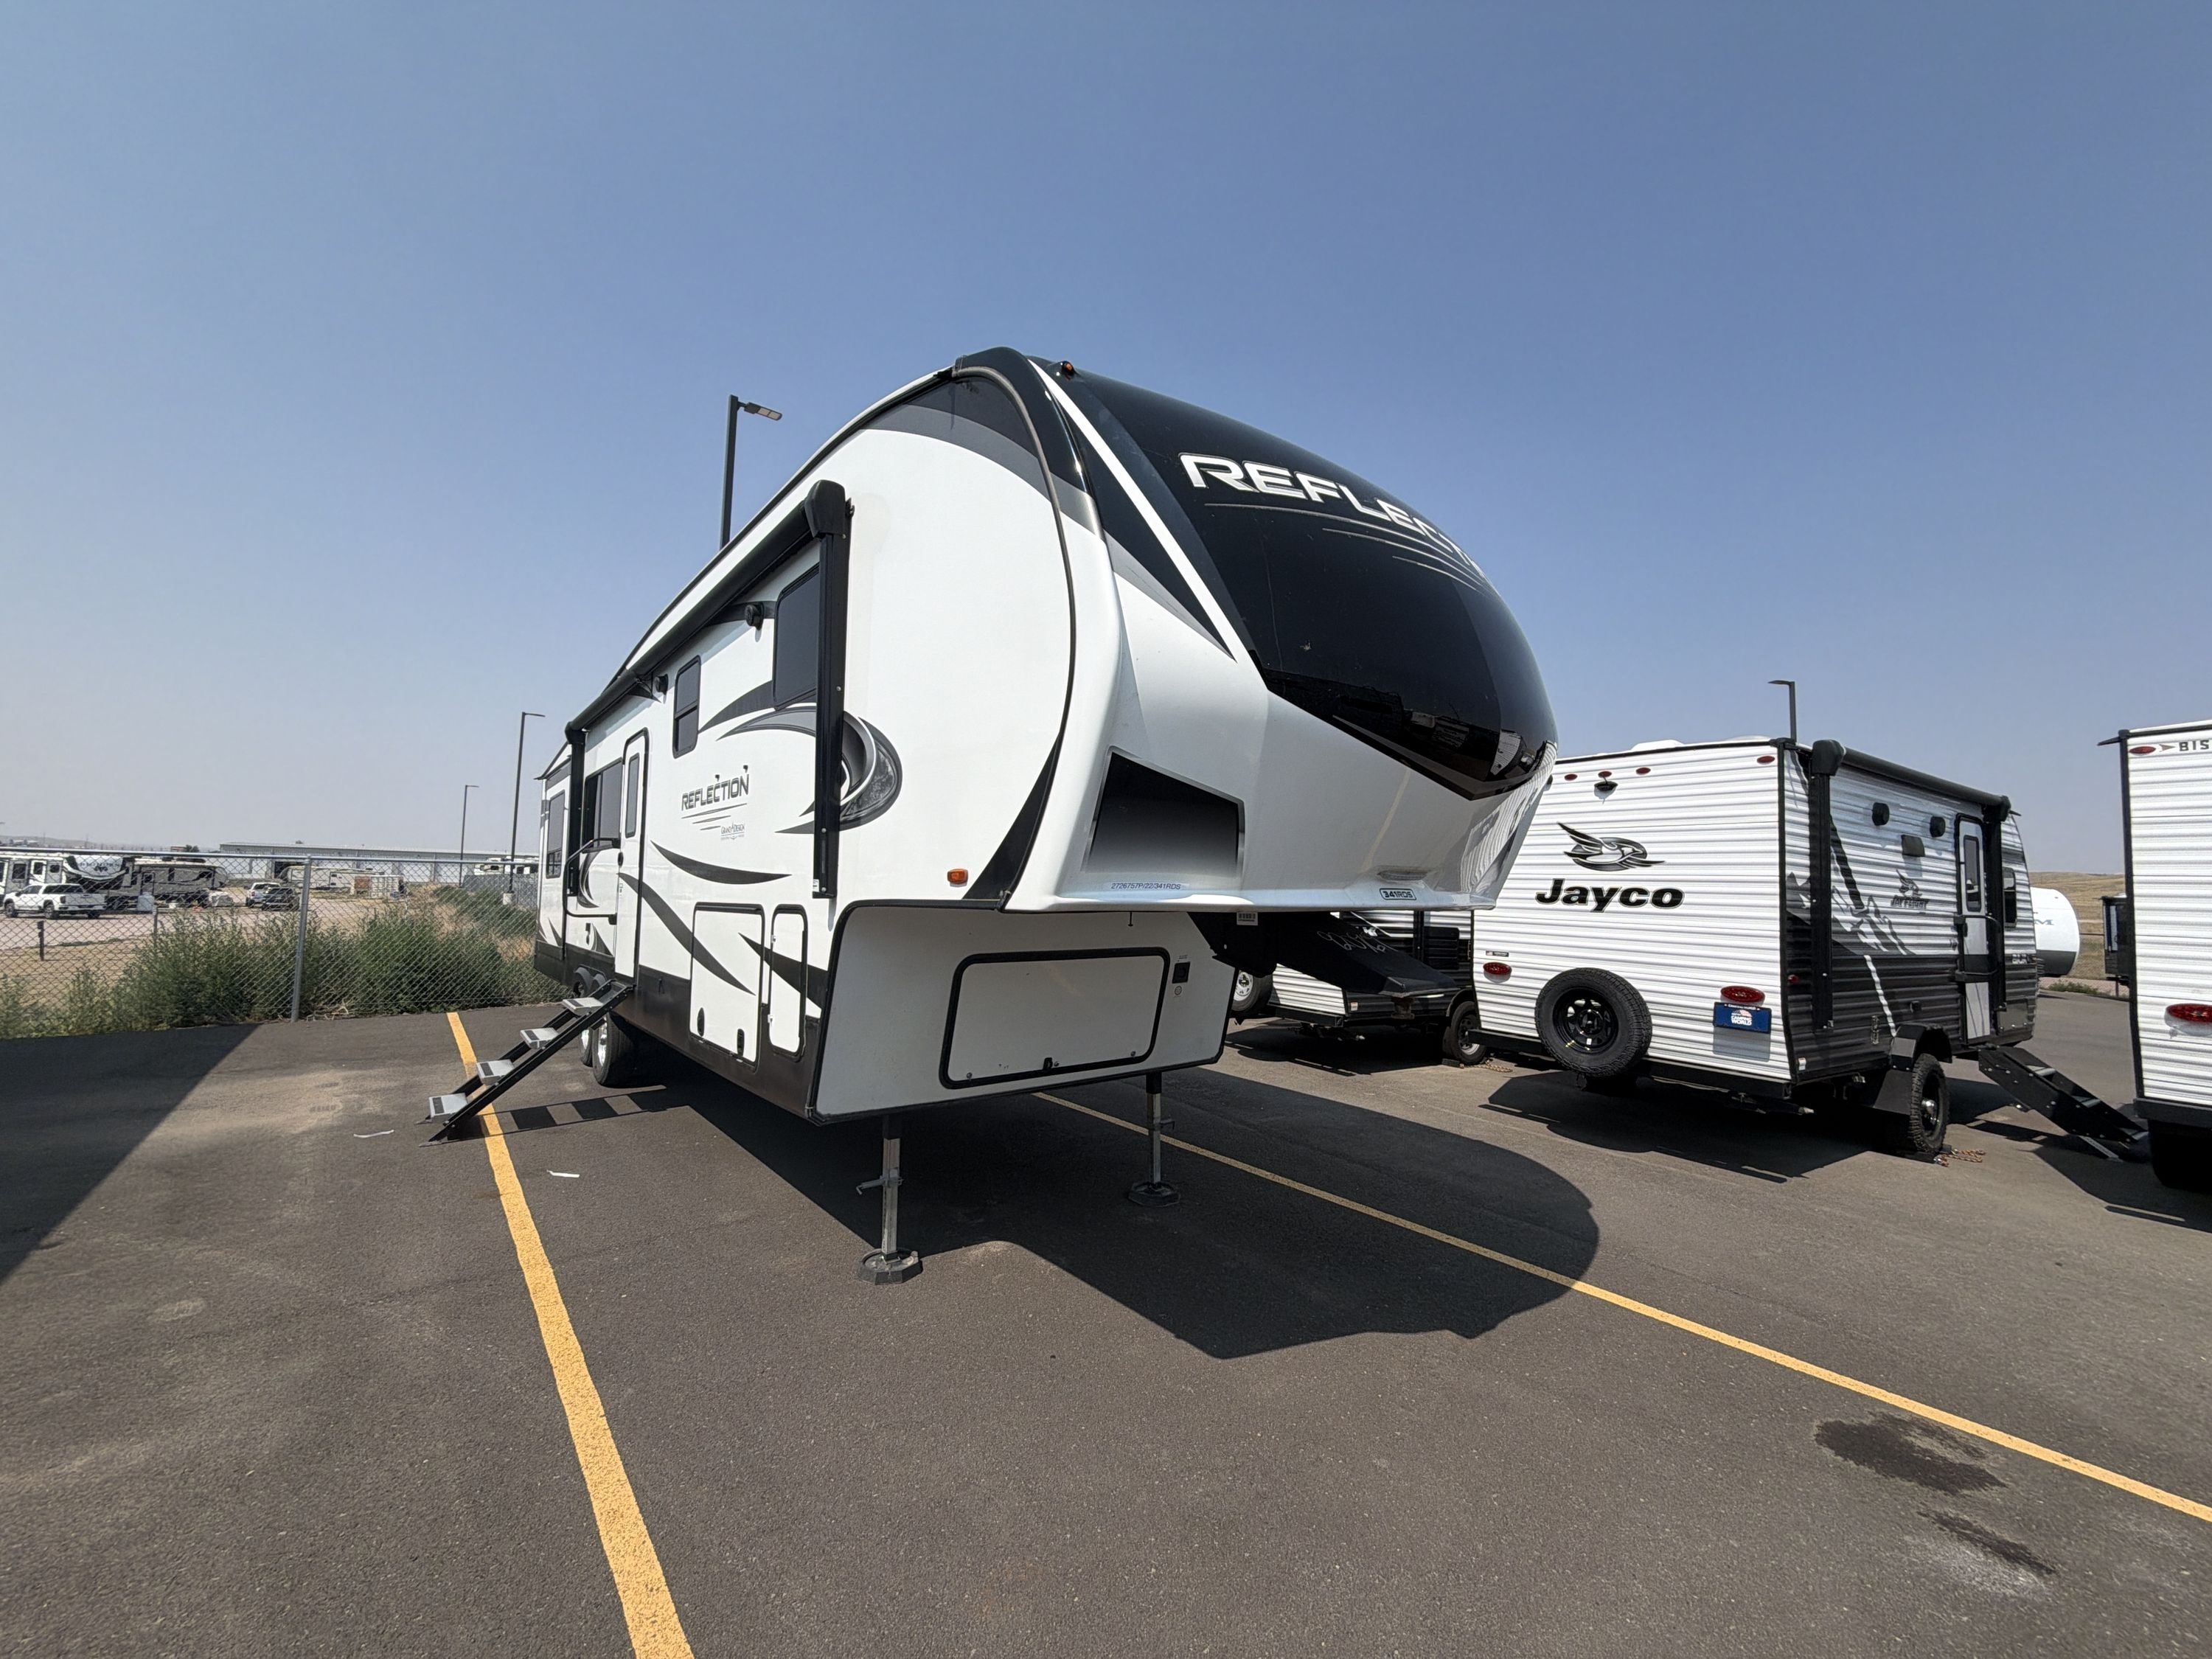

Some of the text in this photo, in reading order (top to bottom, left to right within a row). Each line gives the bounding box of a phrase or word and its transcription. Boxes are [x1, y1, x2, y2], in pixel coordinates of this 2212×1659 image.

[1180, 452, 1500, 595] REFLECT
[681, 773, 750, 811] REFLECTION
[1382, 891, 1413, 899] 341RDS
[1534, 878, 1685, 913] Jayco
